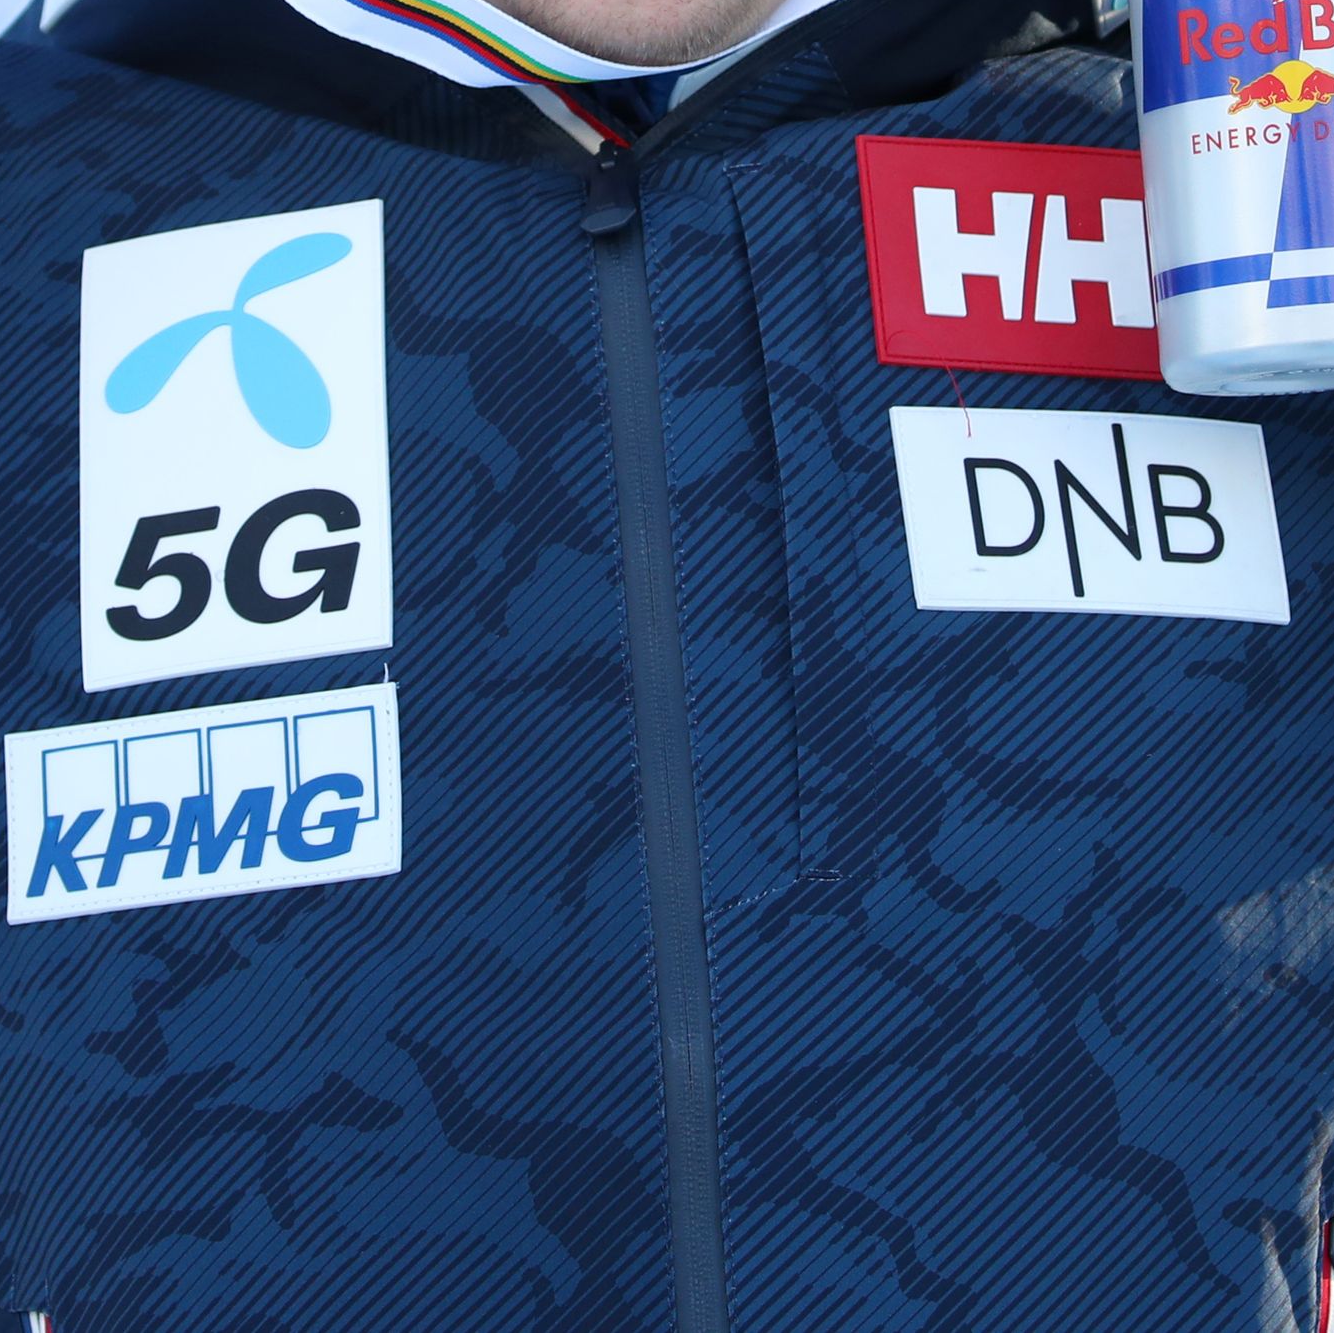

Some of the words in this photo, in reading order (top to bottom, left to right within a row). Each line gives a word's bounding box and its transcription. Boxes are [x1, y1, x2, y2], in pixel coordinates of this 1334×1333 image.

[1191, 122, 1302, 155] ENERGY
[913, 186, 1155, 328] HH
[105, 488, 362, 641] 5G
[964, 423, 1227, 598] DNB
[26, 772, 365, 898] KPMG
